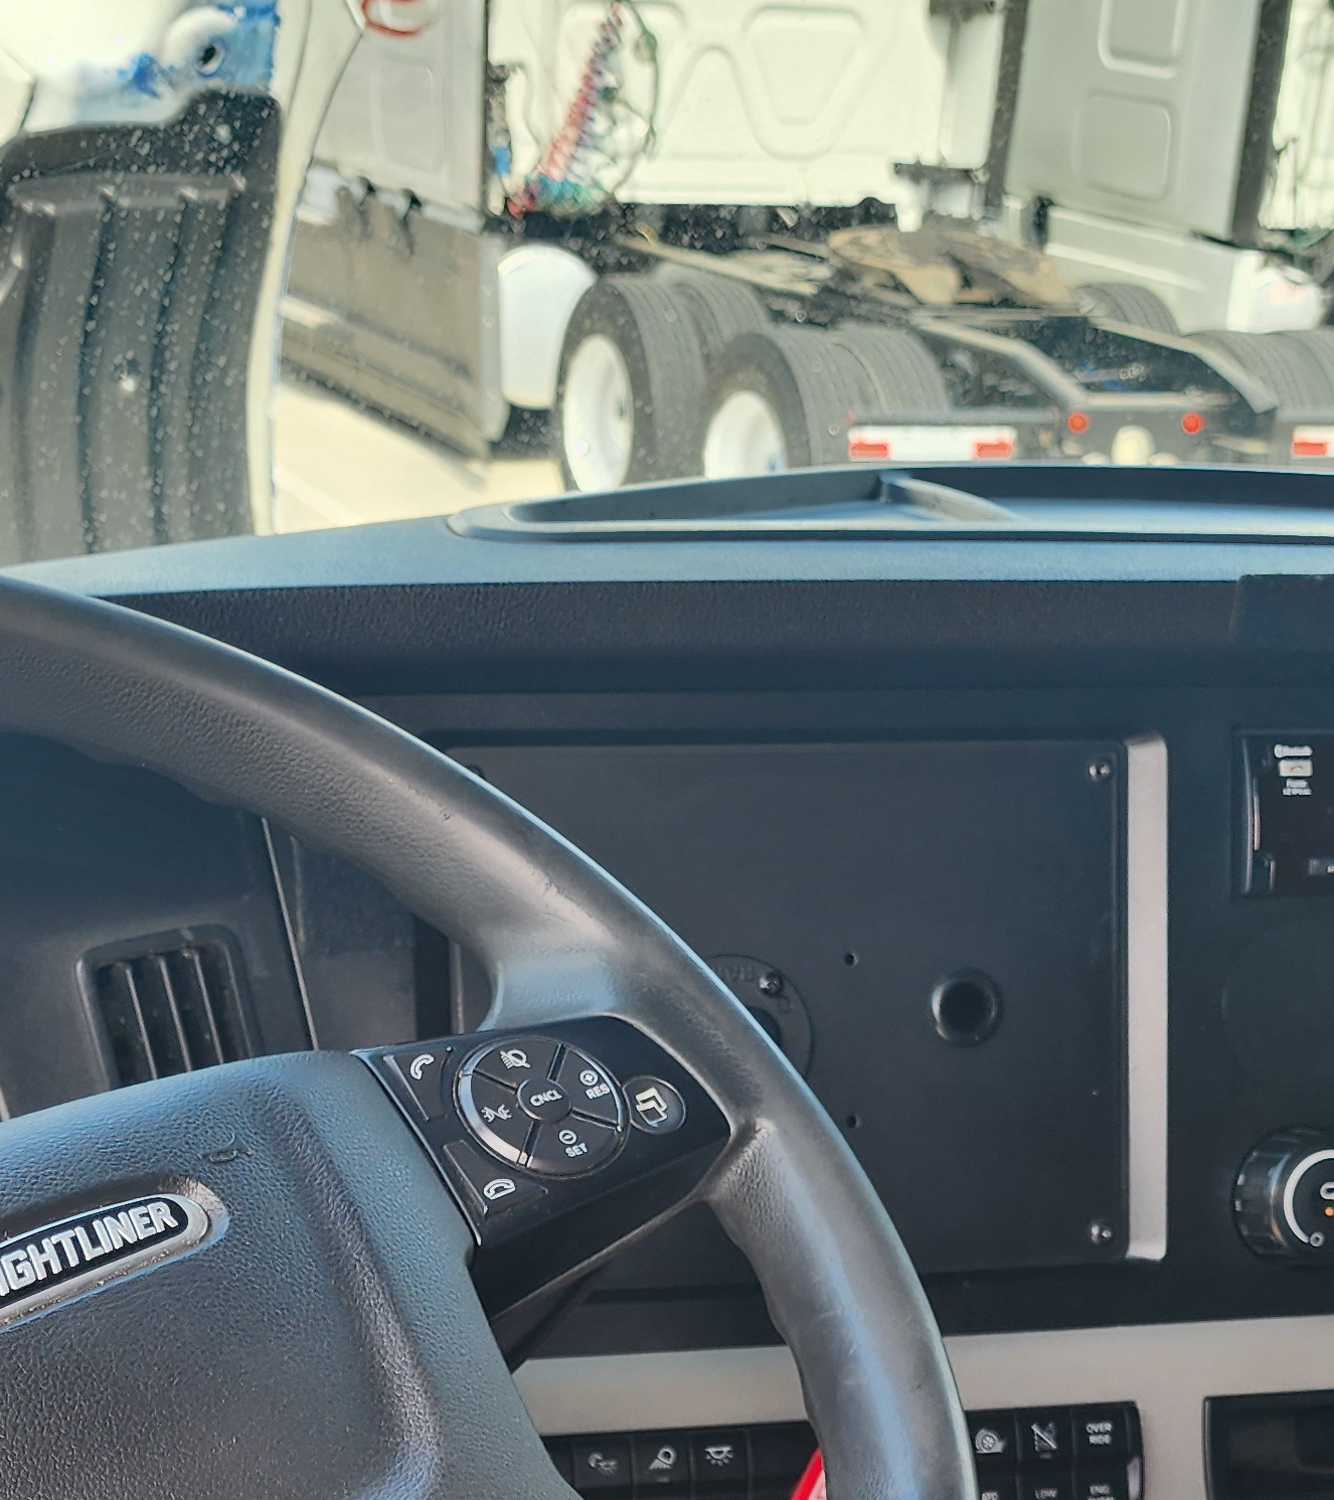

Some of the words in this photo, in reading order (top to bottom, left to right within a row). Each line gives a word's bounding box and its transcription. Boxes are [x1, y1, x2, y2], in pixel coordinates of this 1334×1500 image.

[529, 1089, 563, 1108] CNCL
[585, 1083, 611, 1100] RES
[565, 1142, 589, 1158] SET
[1085, 1421, 1113, 1434] OVER
